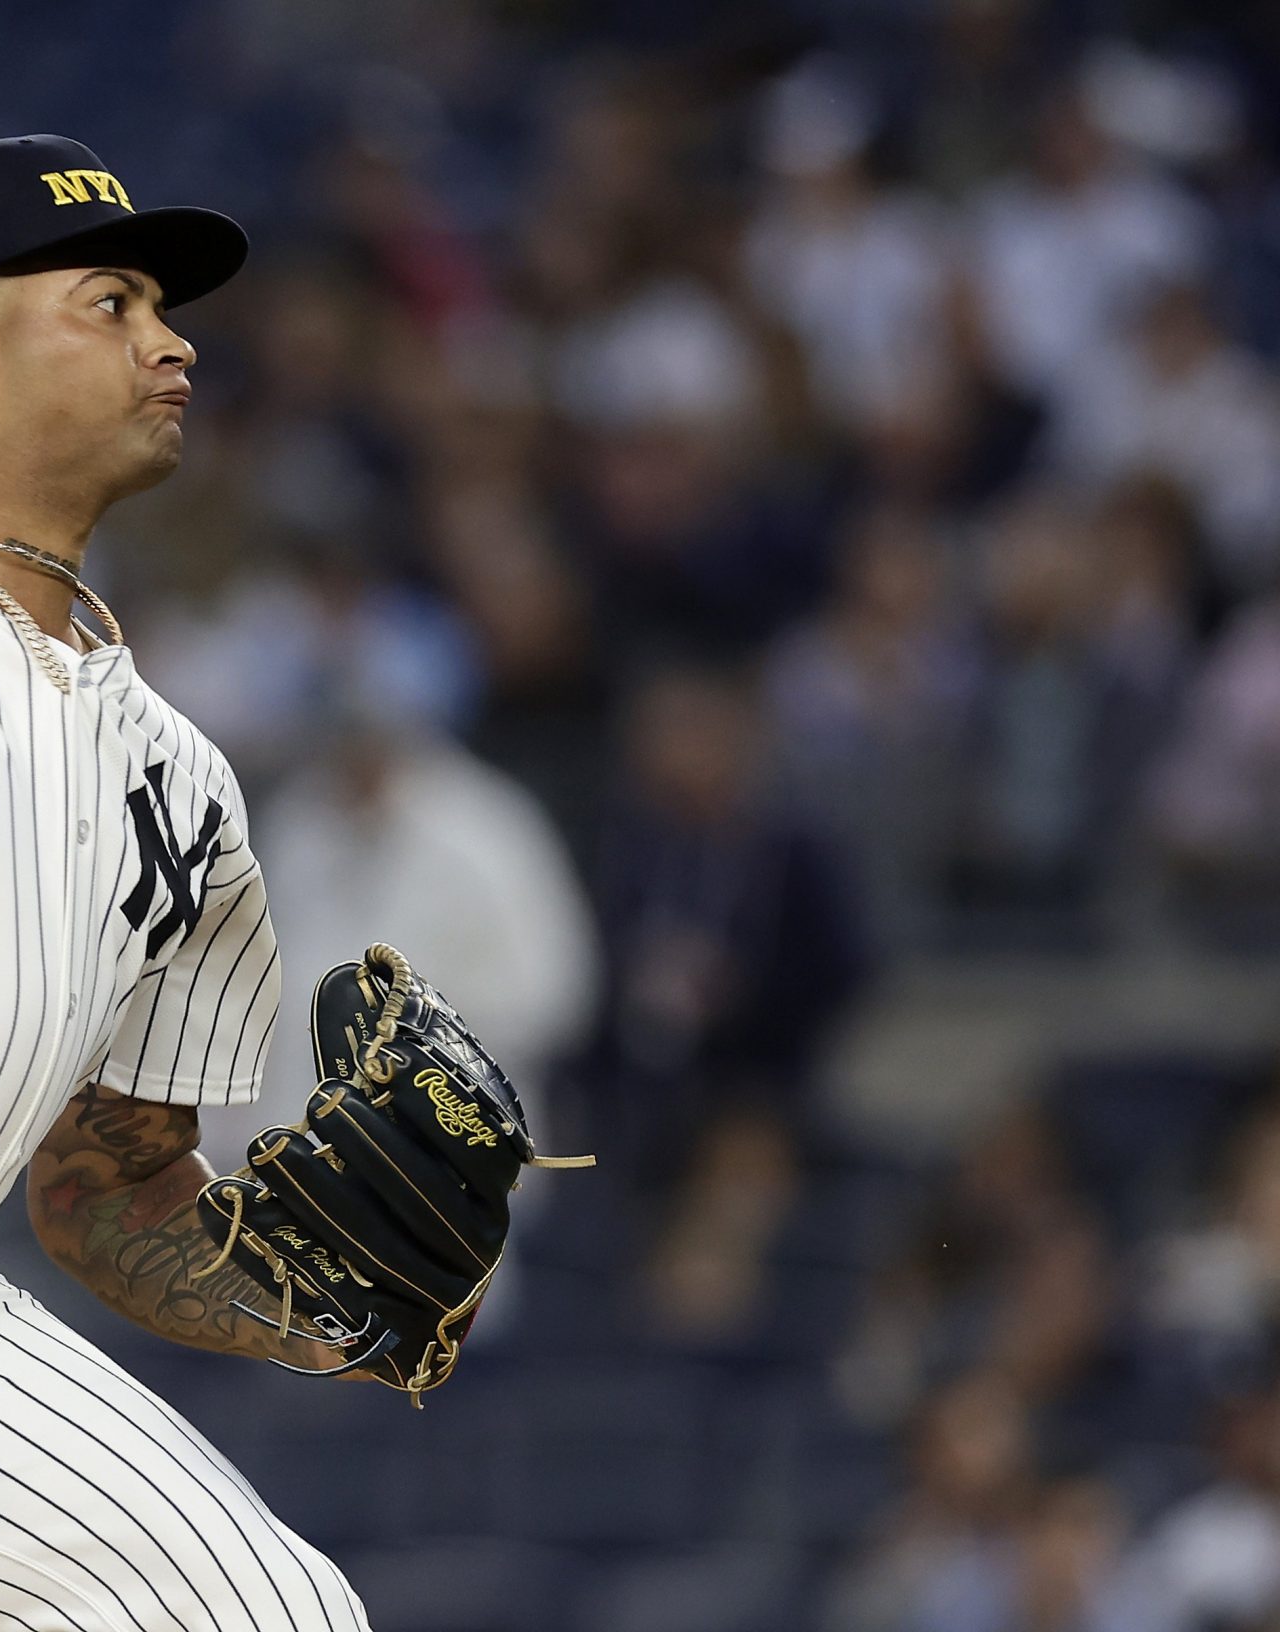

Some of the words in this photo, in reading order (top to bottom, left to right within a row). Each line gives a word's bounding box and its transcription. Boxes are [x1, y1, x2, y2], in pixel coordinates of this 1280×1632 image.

[120, 760, 223, 960] NY
[413, 1068, 498, 1147] Rawlings
[268, 1225, 311, 1250] God
[303, 1247, 346, 1283] First
